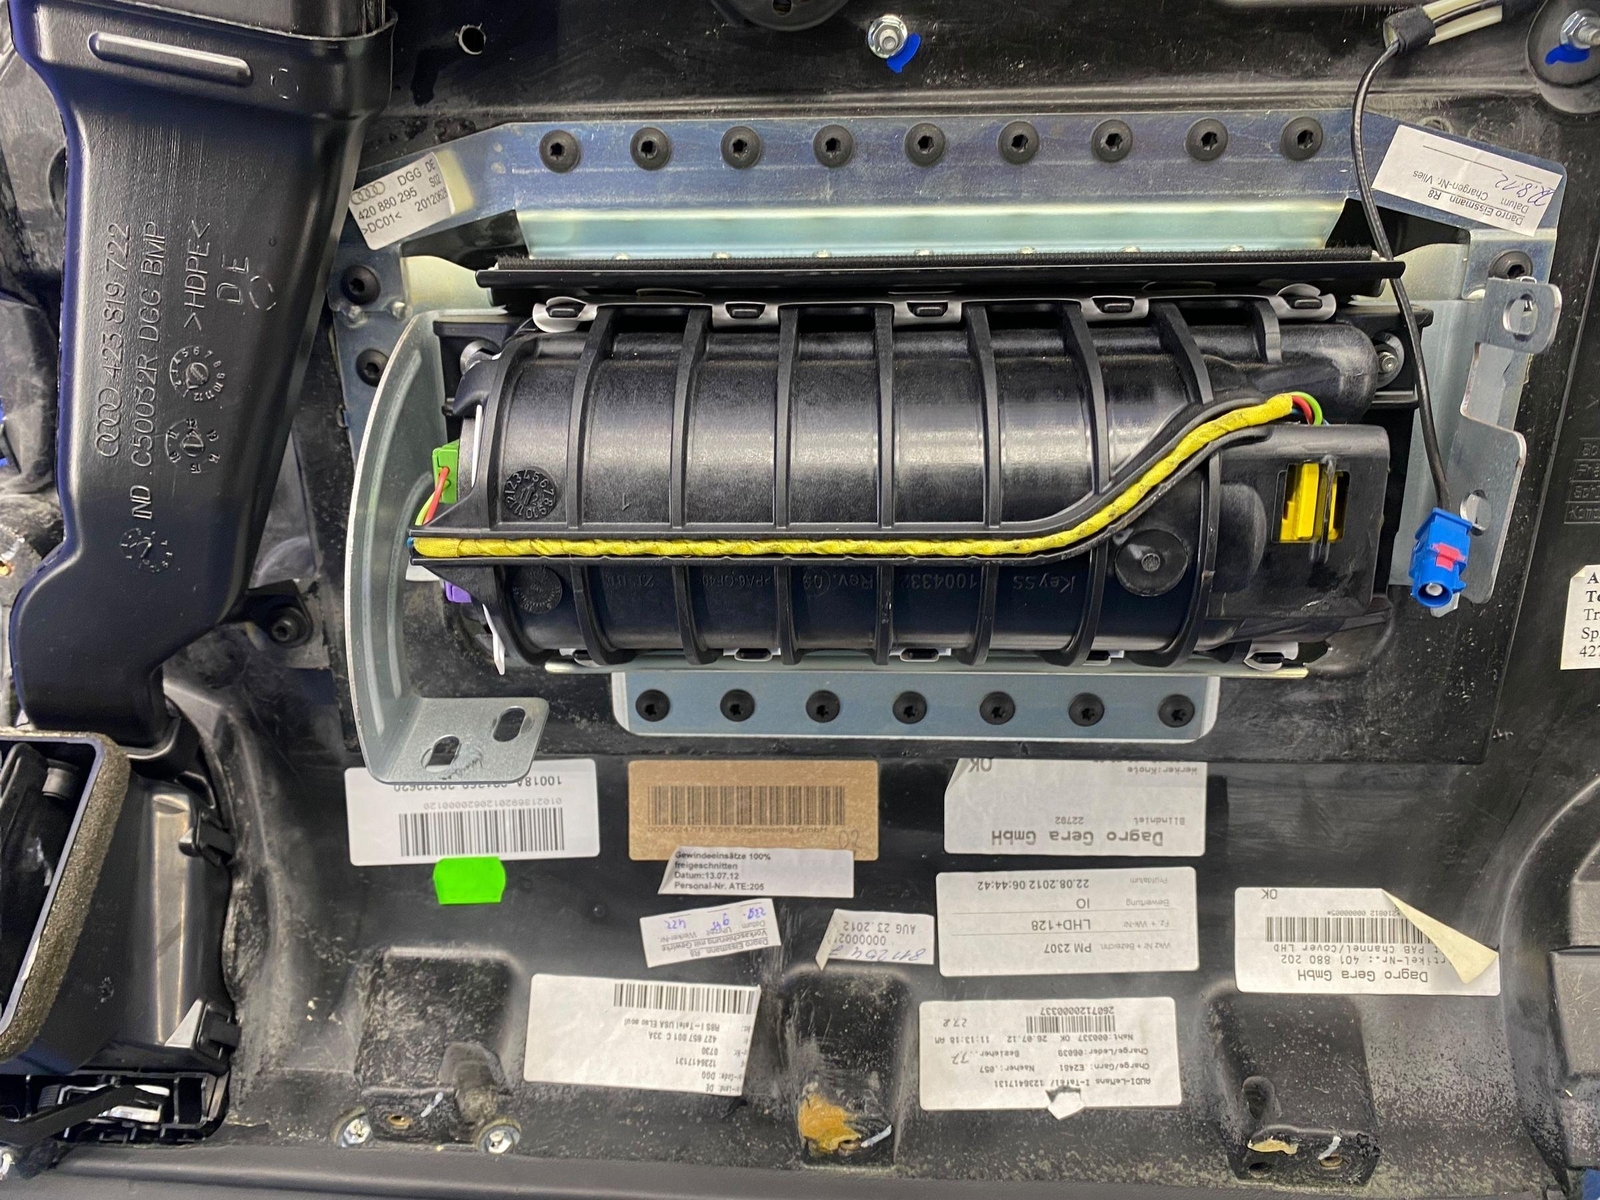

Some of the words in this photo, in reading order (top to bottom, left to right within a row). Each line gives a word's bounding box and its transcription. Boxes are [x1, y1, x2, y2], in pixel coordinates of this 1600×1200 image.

[397, 167, 422, 187] DGG
[1428, 189, 1442, 201] R8
[358, 205, 377, 220] 420
[378, 196, 397, 213] 880
[397, 186, 418, 203] 295
[1449, 195, 1495, 217] Eissmann
[1501, 197, 1530, 214] Datum
[105, 222, 131, 271] 722
[140, 221, 166, 277] BMP
[102, 281, 127, 323] 819
[101, 332, 124, 379] 423
[129, 485, 153, 520] IND
[992, 830, 1037, 847] GmbH
[1049, 831, 1094, 847] Gera
[1106, 829, 1164, 847] Dagro
[675, 851, 747, 861] Gewindeeinsätze
[749, 852, 772, 861] 100%
[675, 861, 738, 871] freigeschnitten
[977, 880, 1026, 890] 06:44:42
[1029, 878, 1090, 889] 22.08.2012
[1260, 888, 1278, 900] OK
[896, 924, 916, 935] AUG
[1031, 918, 1091, 931] LHD+128
[1043, 943, 1070, 953] 2307
[1074, 942, 1092, 953] PM
[1273, 943, 1295, 953] LHD
[1302, 944, 1395, 955] Channel/Cover
[1403, 945, 1425, 955] PAB
[1280, 954, 1301, 965] 202
[1309, 955, 1331, 966] 880
[1339, 955, 1359, 966] 401
[1368, 955, 1450, 966] rtikel-Nr.:
[1297, 968, 1332, 982] GmbH
[1341, 969, 1375, 983] Gera
[1384, 967, 1428, 983] Dagro
